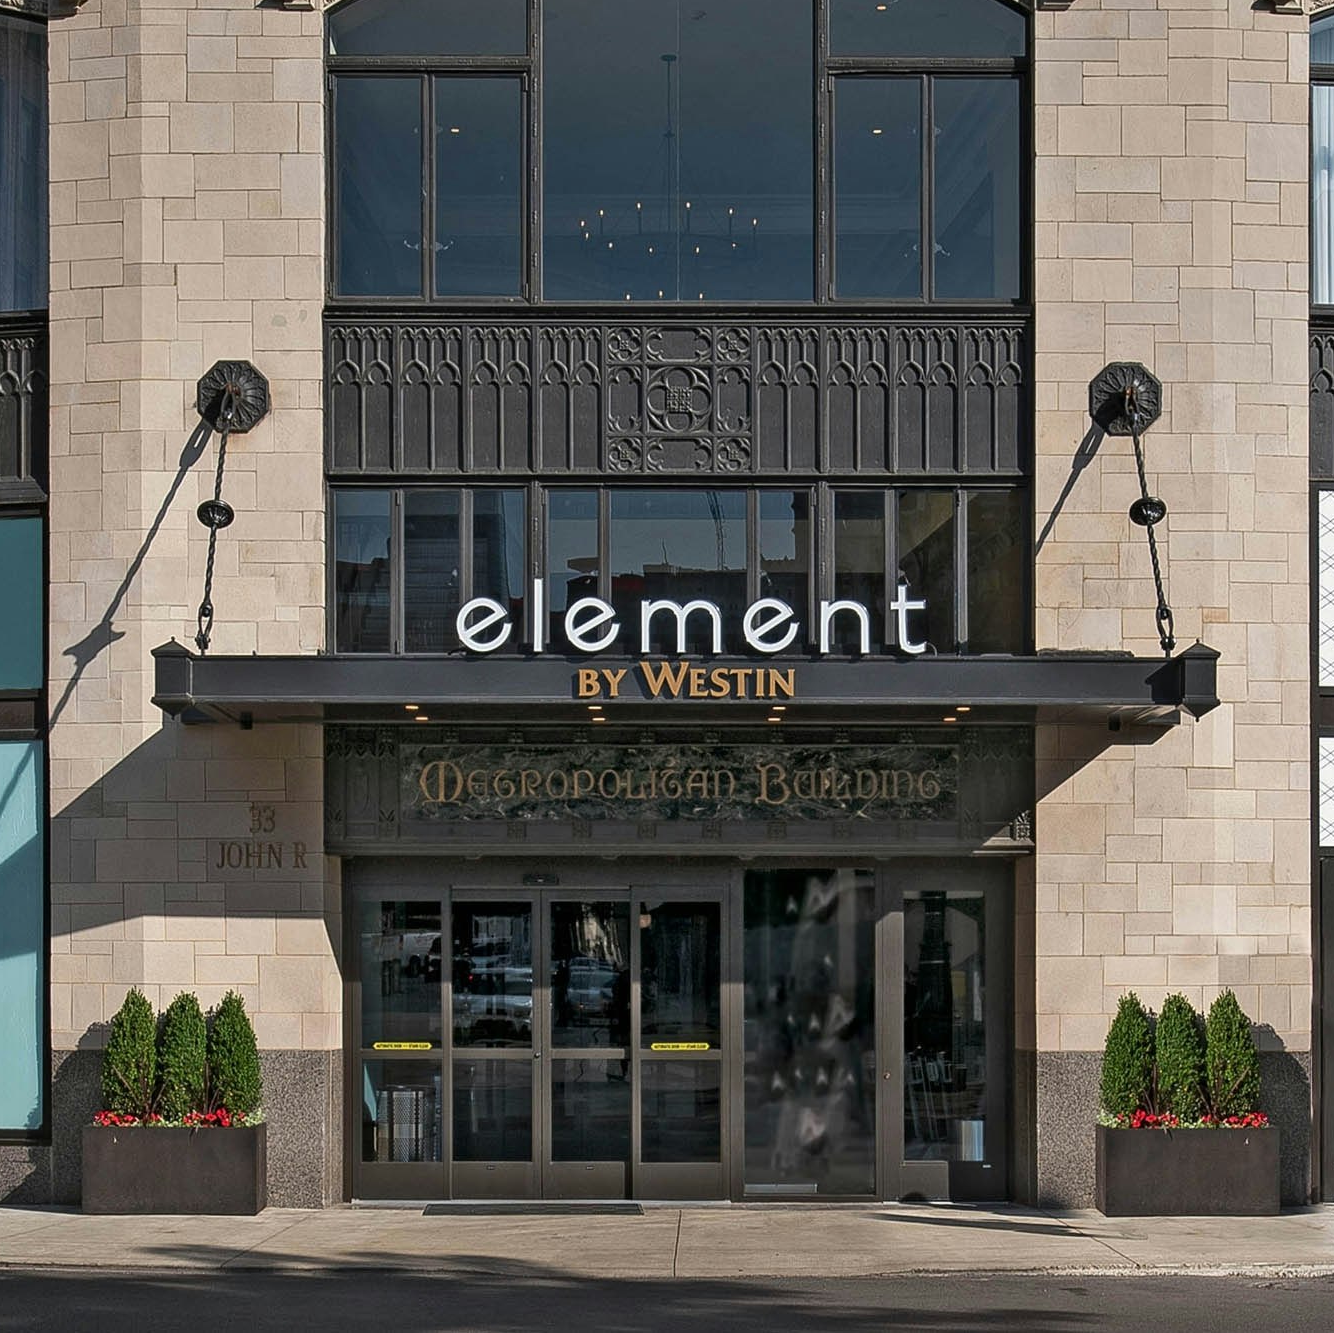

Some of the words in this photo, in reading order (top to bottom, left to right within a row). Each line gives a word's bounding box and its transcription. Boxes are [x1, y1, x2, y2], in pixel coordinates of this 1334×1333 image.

[456, 578, 927, 654] element
[578, 668, 627, 698] BY
[640, 661, 796, 699] WESTIN
[216, 841, 283, 869] JOHN
[292, 841, 308, 869] R
